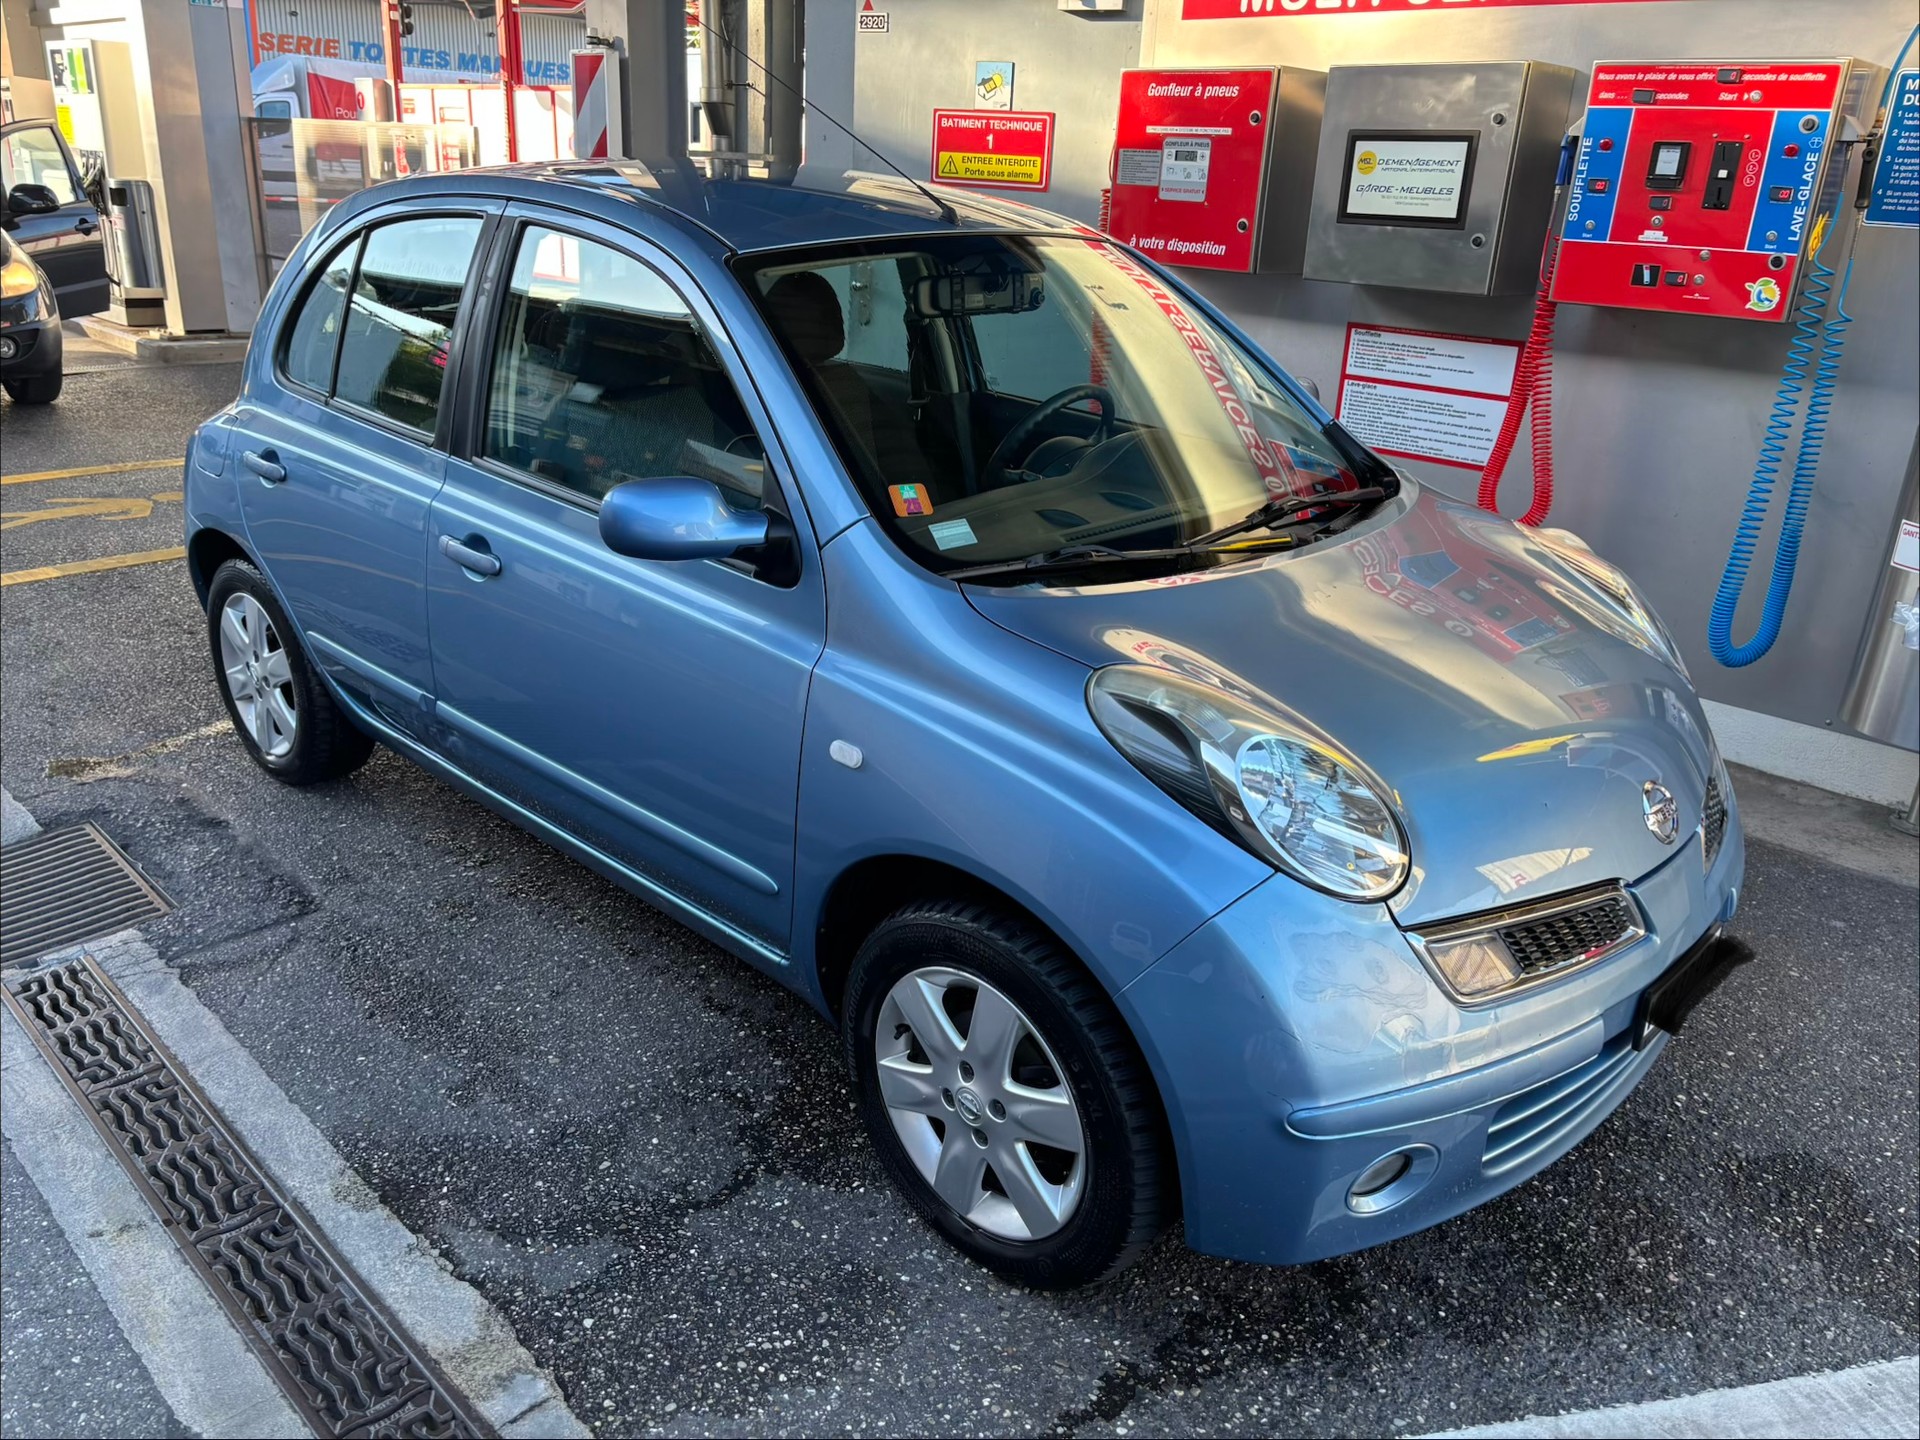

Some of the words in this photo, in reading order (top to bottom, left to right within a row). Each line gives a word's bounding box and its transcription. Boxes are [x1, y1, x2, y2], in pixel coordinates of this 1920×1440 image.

[861, 16, 884, 28] 2920
[258, 32, 340, 58] SERIE
[349, 41, 450, 69] TOTES
[1636, 72, 1644, 80] le
[1643, 72, 1668, 82] plaisir
[1696, 72, 1715, 80] offrir
[1741, 73, 1778, 81] secondes
[1777, 73, 1789, 81] de
[1788, 73, 1827, 81] soufflette
[1148, 83, 1193, 97] Gonfleur
[1195, 82, 1202, 97] à
[1204, 85, 1239, 99] pneus
[1599, 91, 1615, 99] dans
[1718, 92, 1738, 101] Start
[941, 117, 987, 130] BATIMENT
[989, 118, 1043, 132] TECHNIQUE
[986, 133, 993, 150] 1
[961, 156, 993, 166] ENTREE
[995, 157, 1038, 168] INTERDITE
[1885, 155, 1891, 163] 3
[964, 167, 984, 177] Porte
[986, 169, 1005, 178] sous
[1006, 169, 1034, 180] alarme
[1568, 137, 1593, 221] SOUFFLETTE
[1400, 186, 1454, 196] MEUBLES
[1787, 152, 1819, 241] LAVE-GLACE
[1129, 234, 1137, 247] à
[1139, 236, 1165, 250] votre
[1167, 238, 1226, 256] disposition
[1354, 329, 1381, 338] Soufflette
[1347, 380, 1377, 390] Lave-glace
